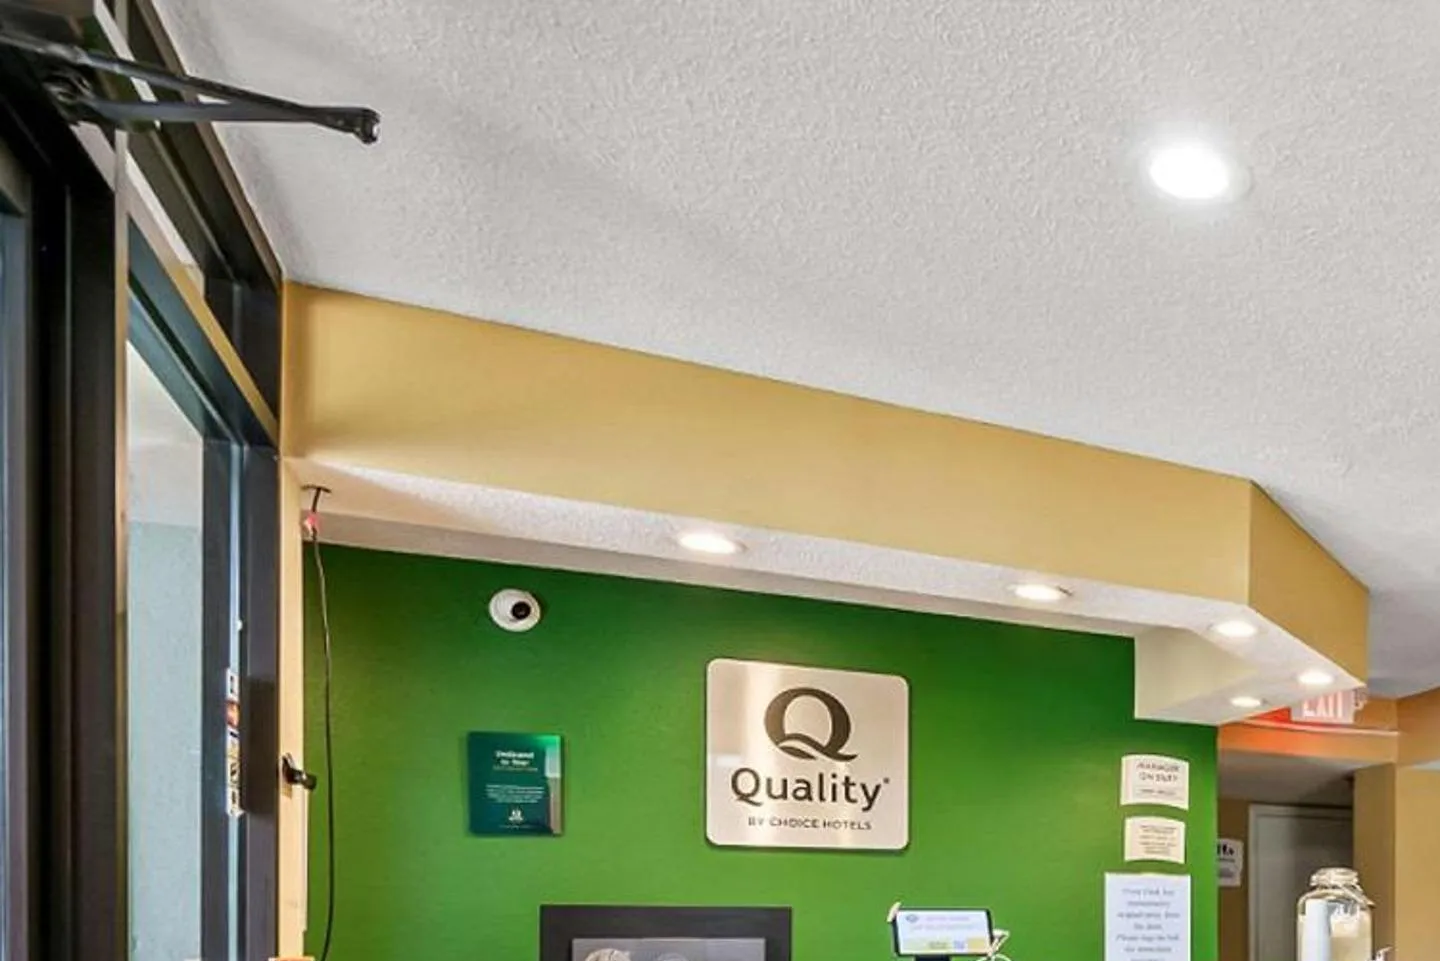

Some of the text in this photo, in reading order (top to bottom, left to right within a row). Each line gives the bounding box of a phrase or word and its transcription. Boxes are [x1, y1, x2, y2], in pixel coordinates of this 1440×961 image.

[730, 767, 882, 813] Quality
[748, 816, 872, 831] BY CHOICE HOTELS
